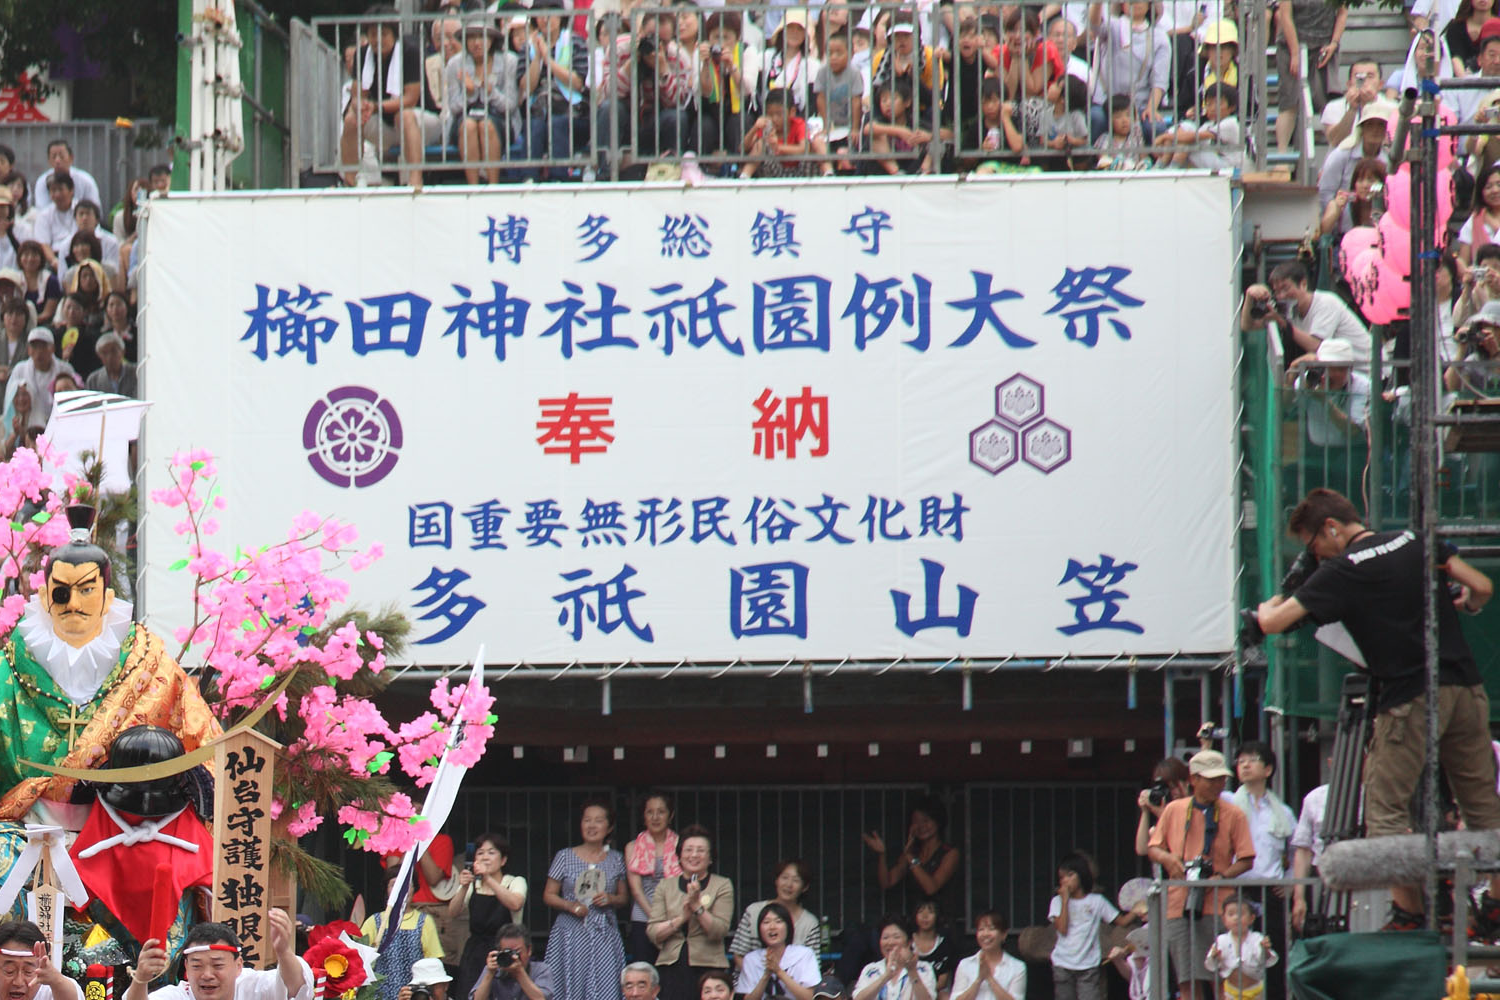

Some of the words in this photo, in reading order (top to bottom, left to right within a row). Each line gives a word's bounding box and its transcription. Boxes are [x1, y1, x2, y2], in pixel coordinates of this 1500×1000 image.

[481, 207, 893, 264] 博多総鎮守
[240, 265, 1146, 366] 櫛田神社祇園例大祭
[536, 386, 830, 464] 奉納
[407, 493, 971, 551] 国重要無形民俗文化財
[258, 554, 1145, 646] 多祇園山笠
